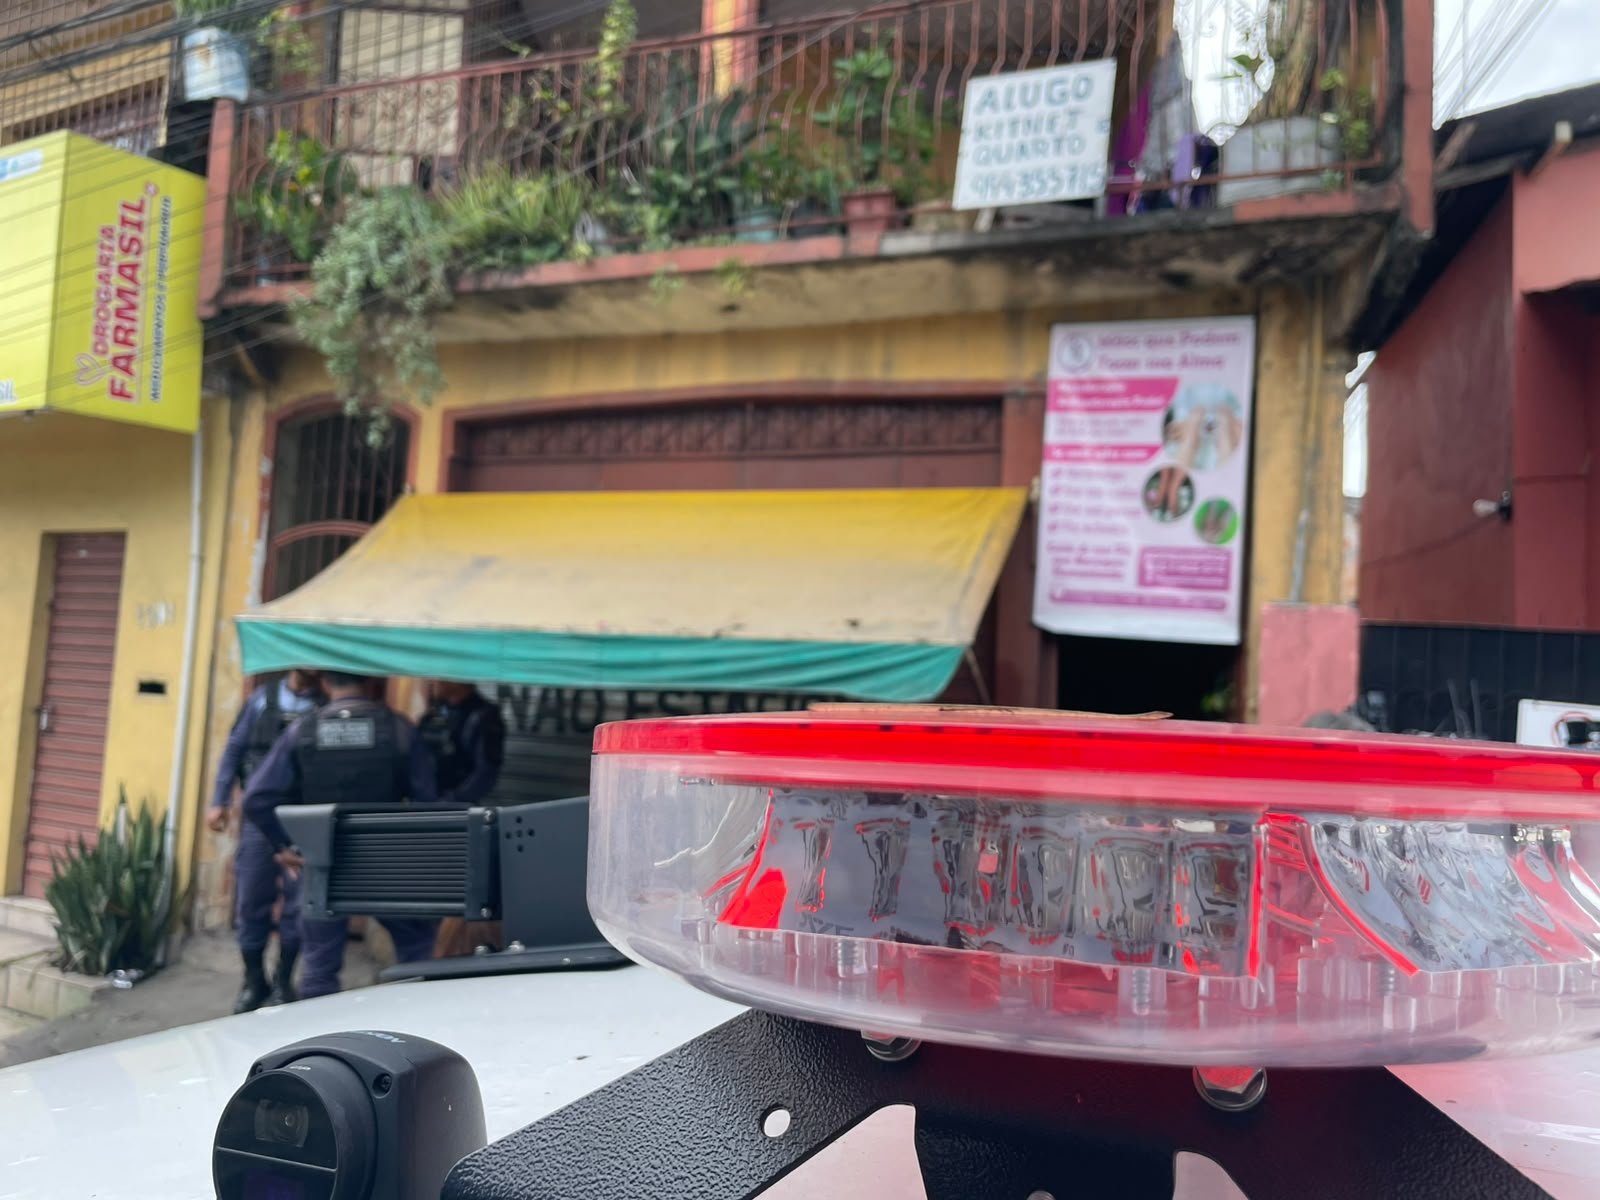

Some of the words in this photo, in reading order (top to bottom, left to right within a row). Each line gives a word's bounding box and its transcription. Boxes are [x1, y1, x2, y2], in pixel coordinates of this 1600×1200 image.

[973, 72, 1094, 115] ALUGO
[973, 133, 1086, 166] QUARTO
[93, 224, 115, 356] DROGARIA
[111, 198, 145, 400] FARMASIL
